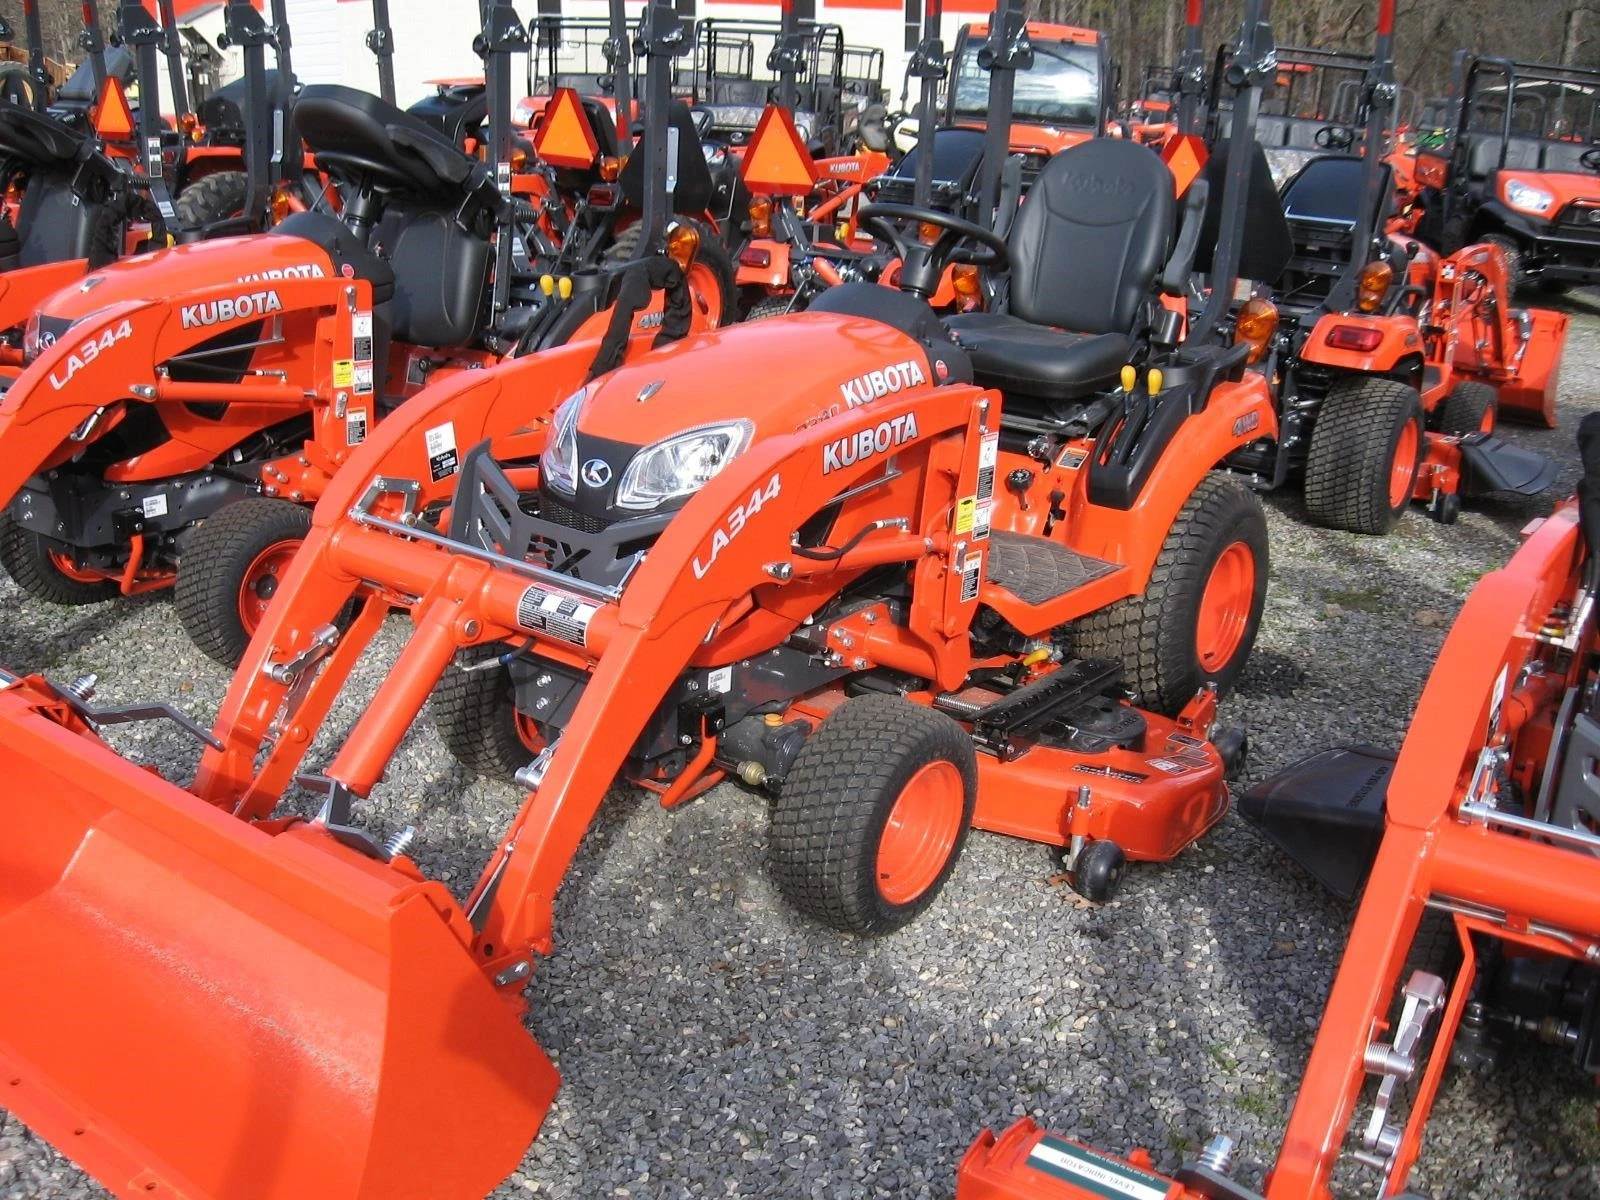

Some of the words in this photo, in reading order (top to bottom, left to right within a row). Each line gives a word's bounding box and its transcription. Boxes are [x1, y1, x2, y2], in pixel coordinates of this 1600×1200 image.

[829, 161, 860, 173] KUBOTA
[181, 290, 283, 329] KUBOTA
[49, 319, 133, 391] LA344
[840, 360, 926, 410] KUBOTA
[823, 411, 918, 475] KUBOTA
[692, 472, 782, 580] LA344
[1108, 1175, 1137, 1192] LEVEL
